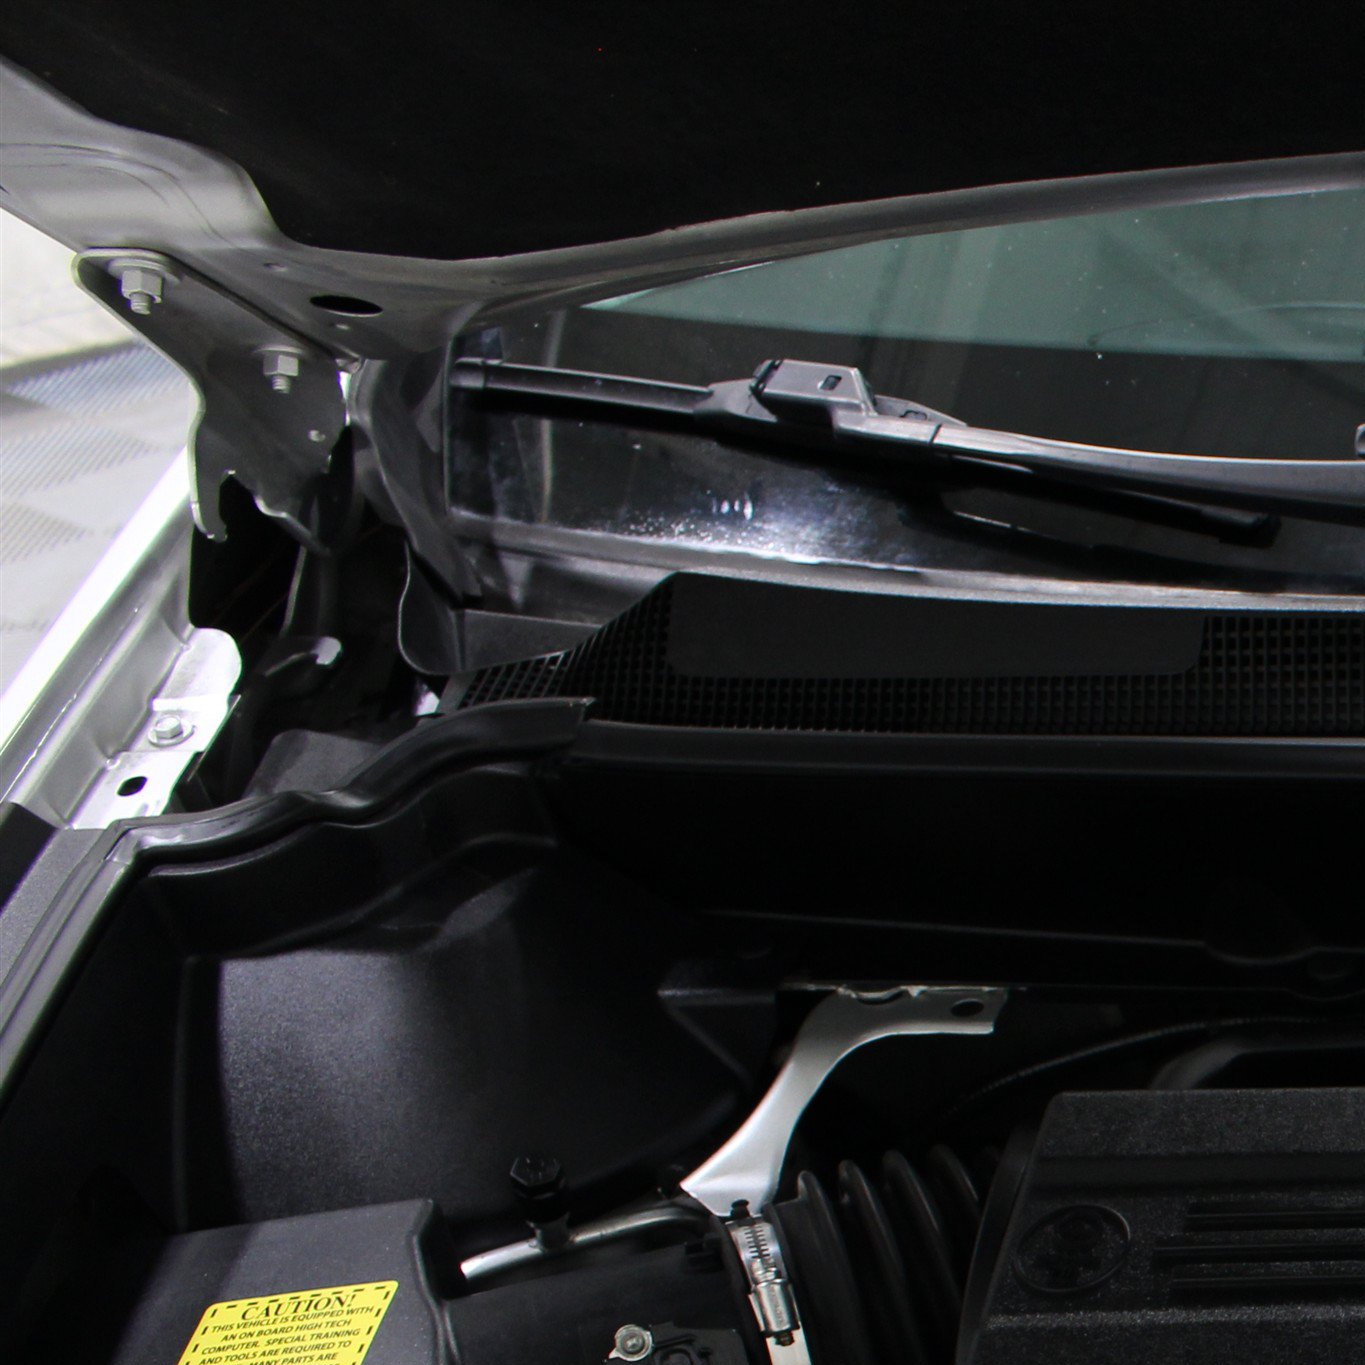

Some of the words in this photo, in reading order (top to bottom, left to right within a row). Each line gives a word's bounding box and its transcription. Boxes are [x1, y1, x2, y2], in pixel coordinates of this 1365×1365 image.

[241, 1294, 356, 1320] CAUTION!
[212, 1324, 234, 1332] THIS
[237, 1319, 277, 1328] VEHICLE
[291, 1310, 343, 1322] EQUIPPED
[346, 1306, 374, 1315] WITH
[221, 1333, 237, 1342] AN
[239, 1331, 255, 1339] ON
[256, 1326, 293, 1337] BOARD
[295, 1323, 322, 1331] HIGH
[325, 1320, 351, 1328] TECH
[265, 1335, 306, 1346] SPECIAL
[310, 1328, 361, 1339] TRAINING
[199, 1357, 223, 1365] AND
[224, 1351, 258, 1361] TOOLS
[259, 1349, 280, 1357] ARE
[282, 1342, 335, 1354] REQUIRED
[281, 1355, 316, 1365] PARTS
